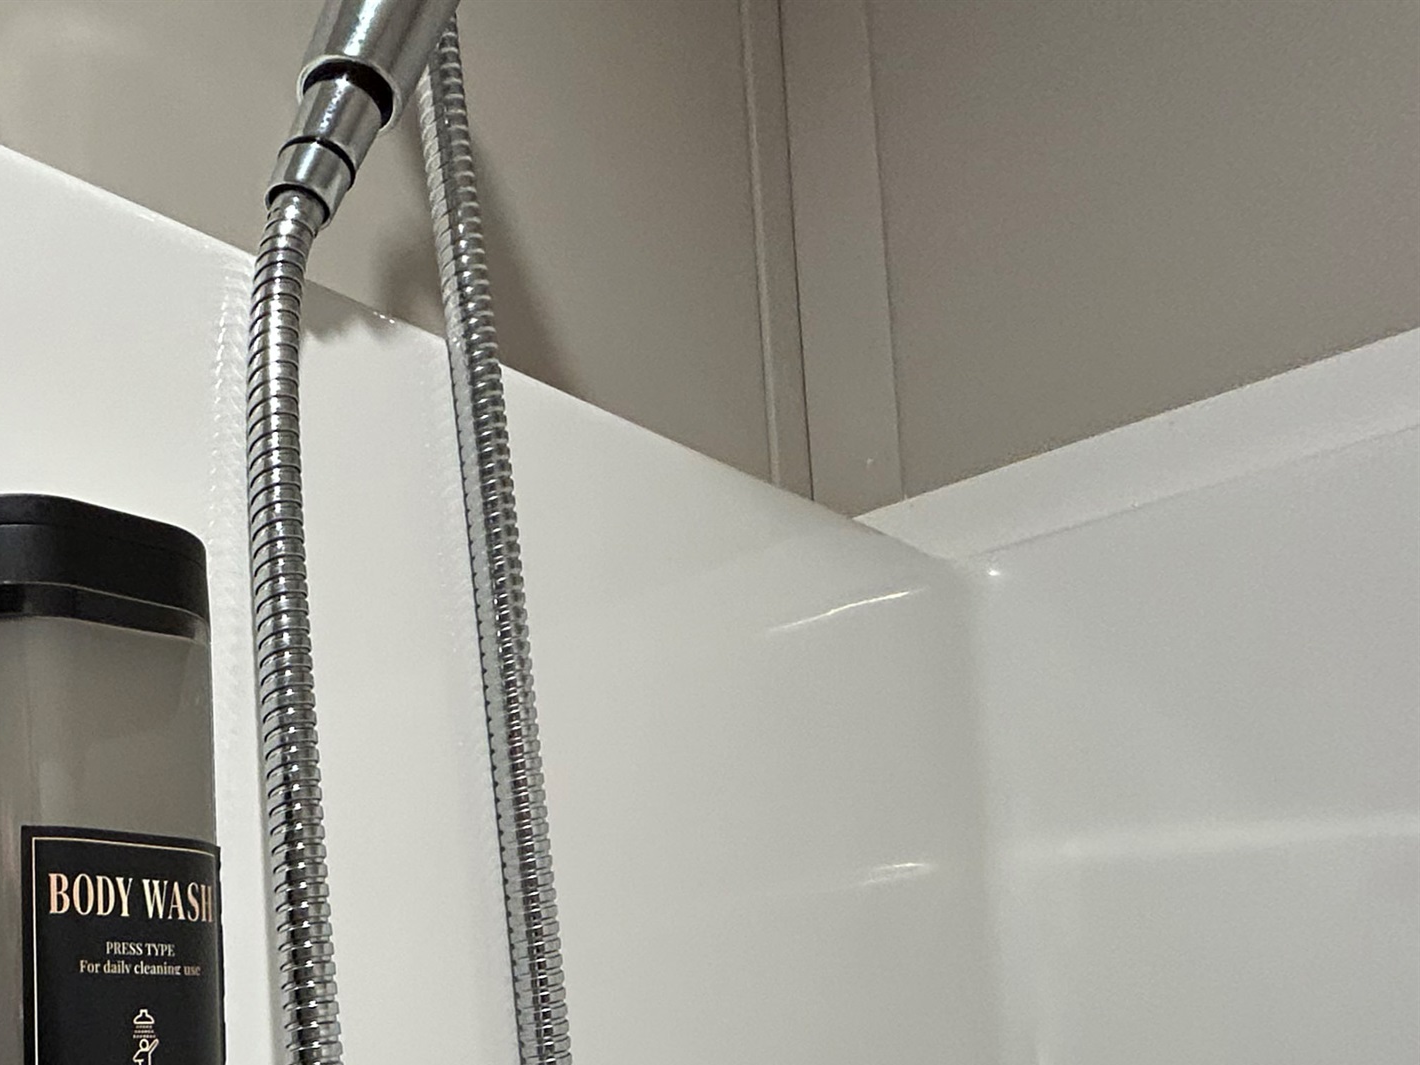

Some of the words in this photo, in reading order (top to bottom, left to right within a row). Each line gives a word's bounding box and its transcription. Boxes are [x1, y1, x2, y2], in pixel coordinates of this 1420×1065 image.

[48, 873, 133, 918] BODY
[143, 878, 213, 923] WASH
[106, 942, 143, 956] PRESS
[145, 943, 175, 957] TYPE
[80, 960, 100, 973] For
[104, 960, 131, 975] daily
[134, 961, 181, 975] cleaning
[184, 964, 201, 976] use
